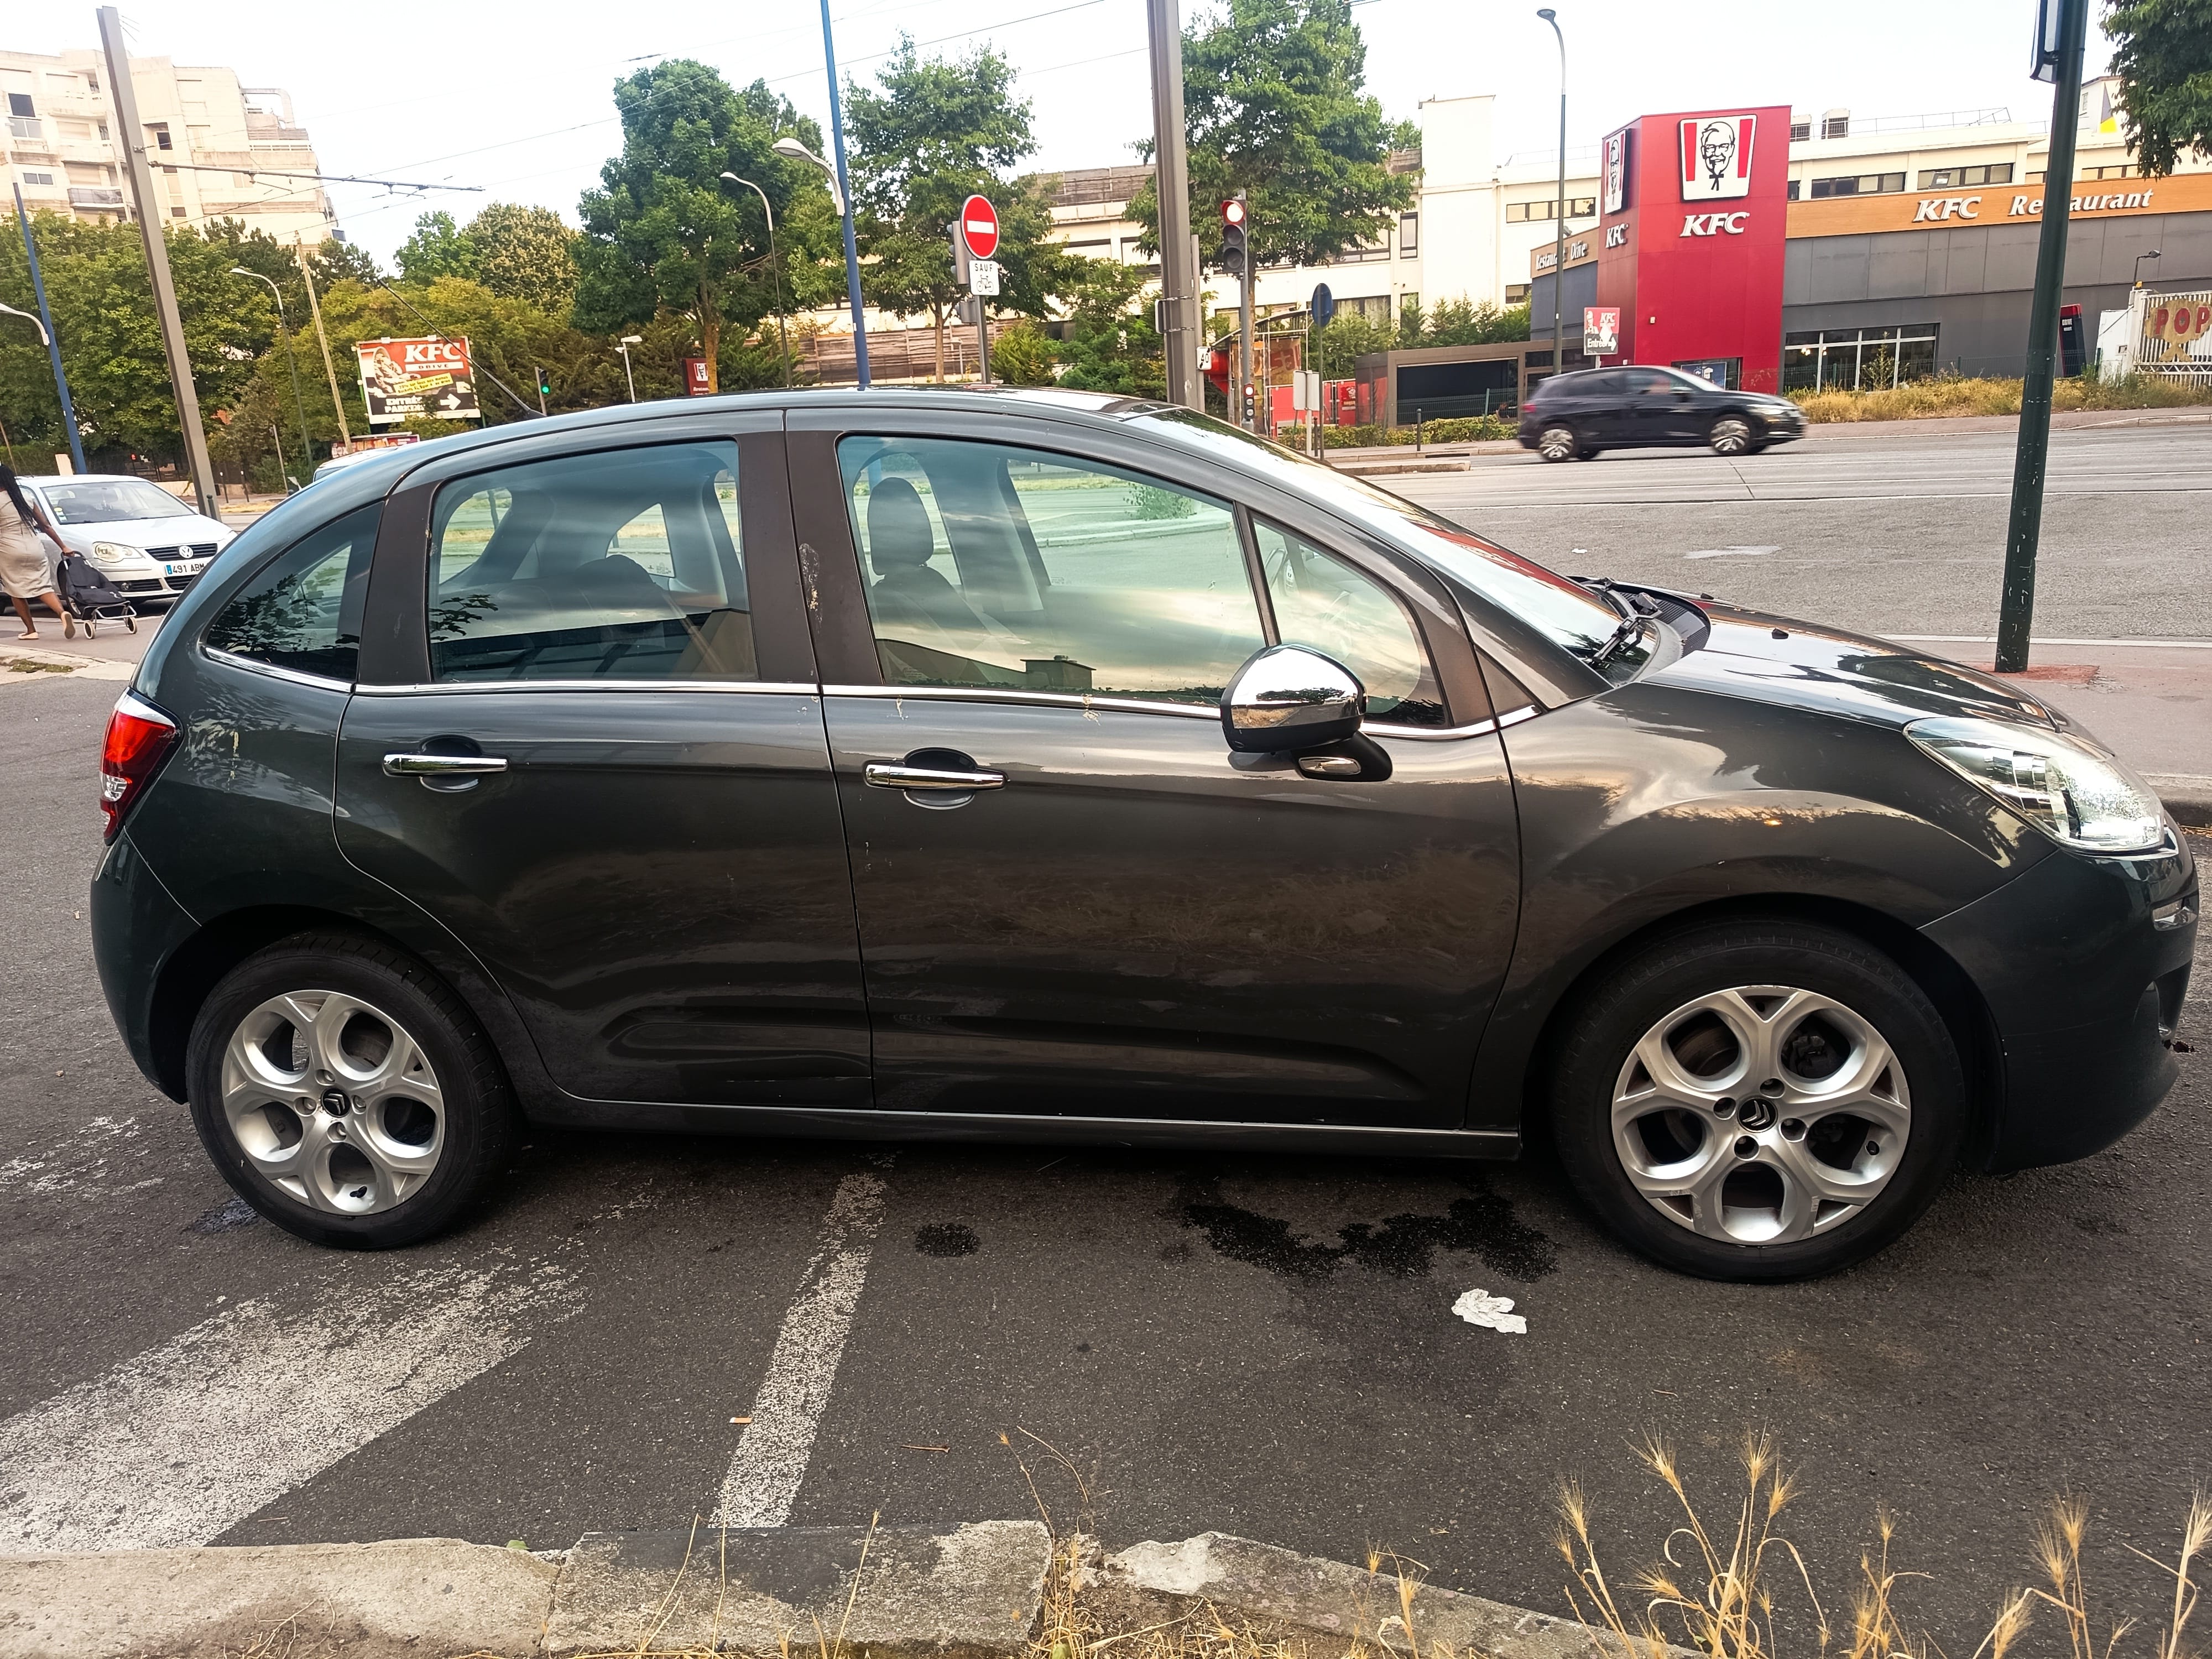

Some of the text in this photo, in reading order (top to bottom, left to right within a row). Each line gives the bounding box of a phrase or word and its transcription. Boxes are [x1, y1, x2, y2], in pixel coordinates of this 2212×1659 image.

[1913, 189, 2154, 222] KFC Reaurant
[1679, 211, 1750, 237] KFC
[1605, 223, 1628, 249] KFC
[974, 263, 993, 272] SAUF
[1600, 312, 1616, 324] KFC
[2154, 305, 2210, 336] POP
[405, 343, 461, 362] KFC
[173, 565, 187, 573] 491
